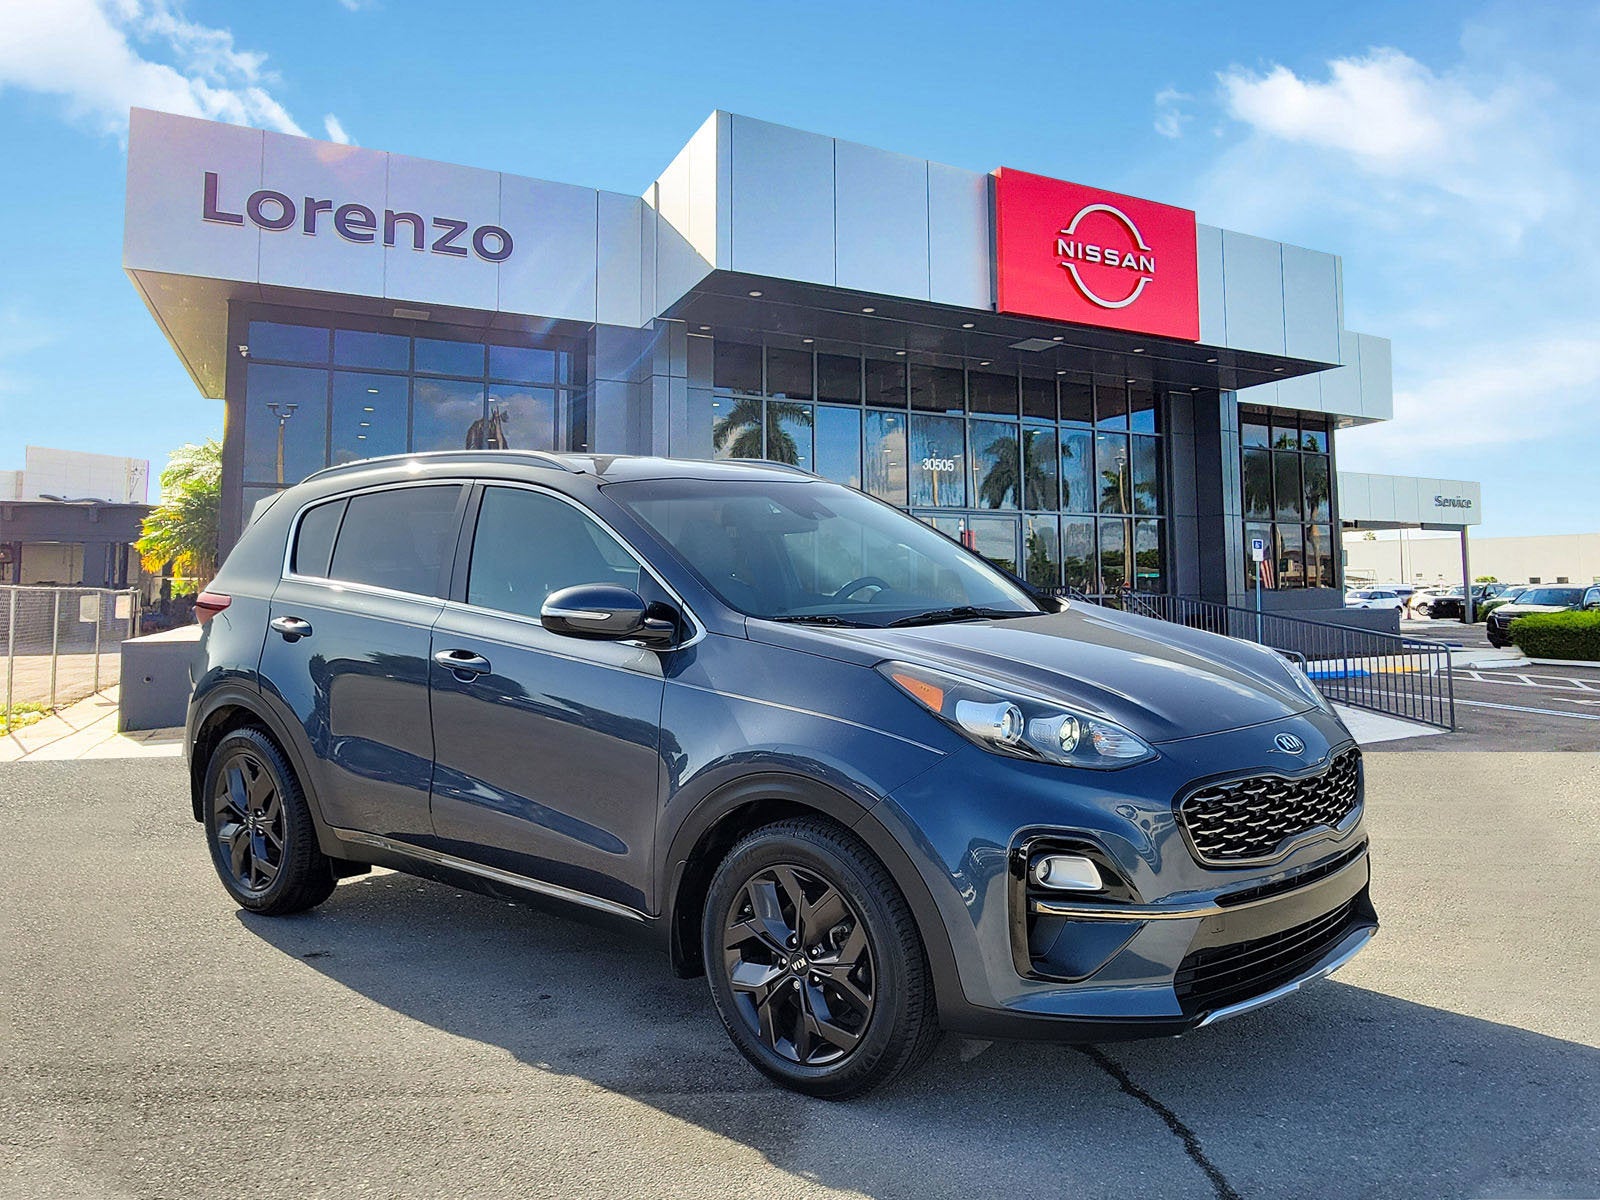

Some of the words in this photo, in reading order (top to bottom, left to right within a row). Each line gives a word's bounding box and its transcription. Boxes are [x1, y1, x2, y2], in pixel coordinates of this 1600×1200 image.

[202, 170, 514, 261] Lorenzo
[1058, 238, 1155, 273] NISSAN
[922, 457, 955, 471] 30505
[1434, 495, 1472, 508] Service
[1278, 735, 1302, 750] KIA
[791, 957, 807, 970] KIA
